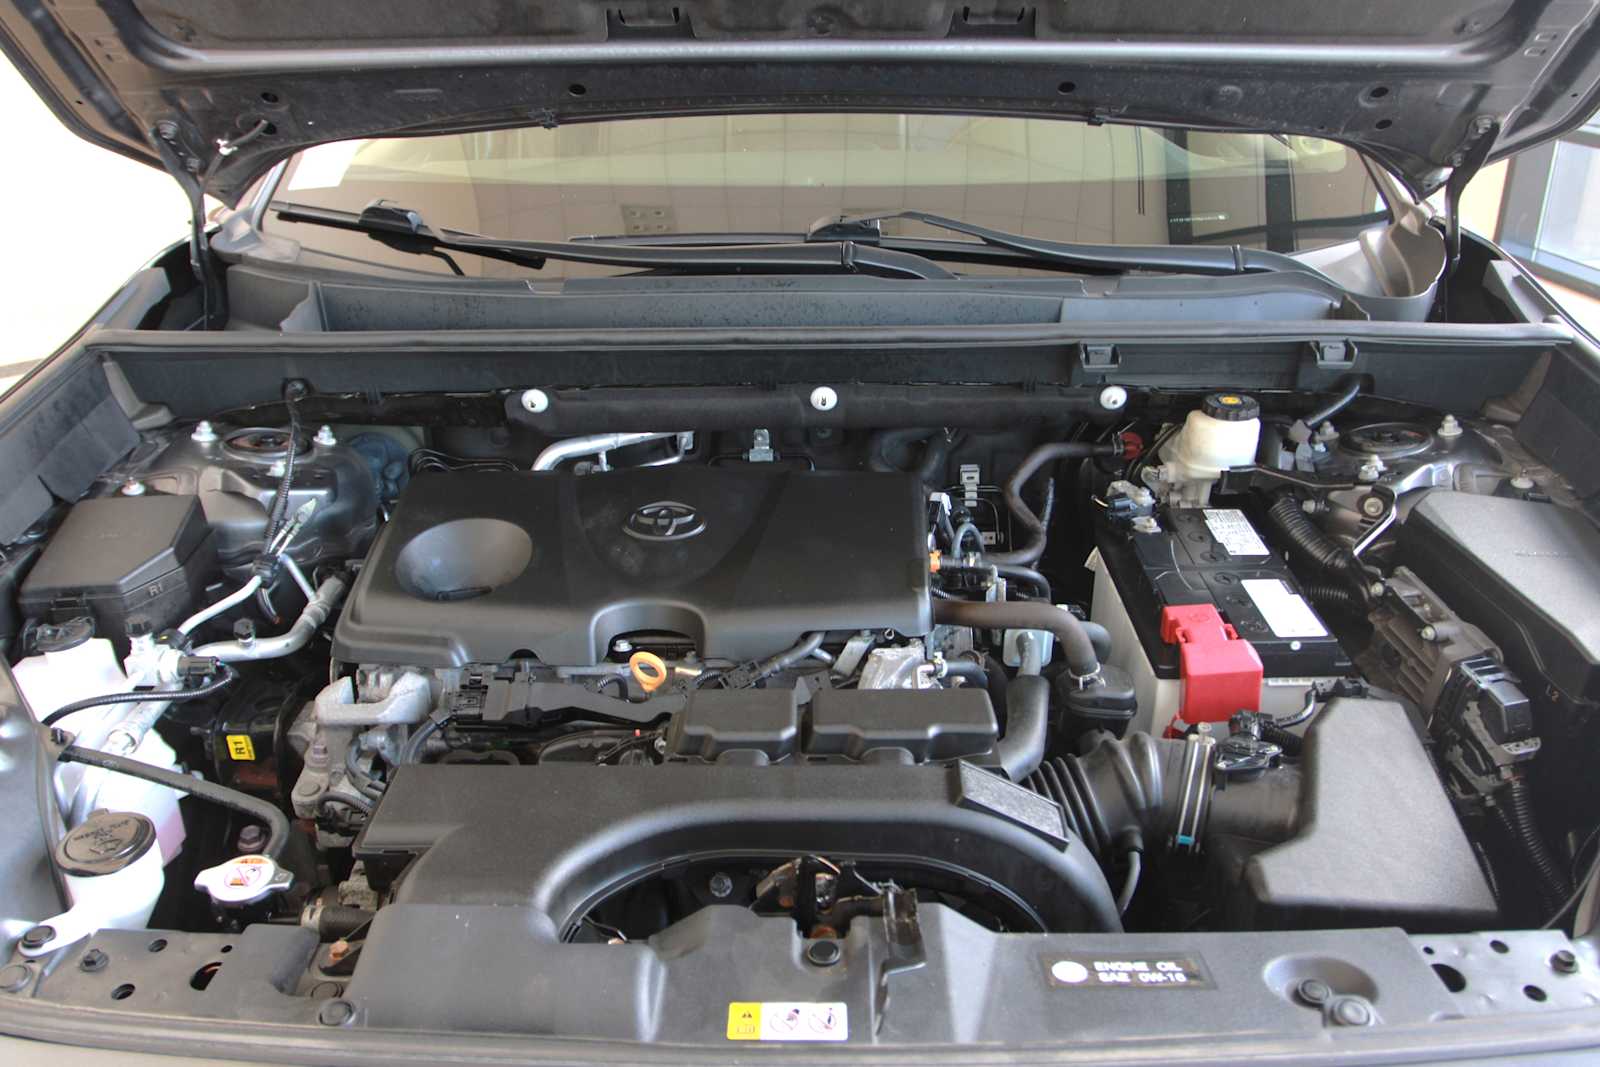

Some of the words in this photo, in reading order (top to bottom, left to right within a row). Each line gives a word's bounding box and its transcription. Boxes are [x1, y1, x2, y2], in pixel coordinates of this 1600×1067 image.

[1093, 961, 1150, 972] ENGINE
[1155, 961, 1183, 972] OIL
[1098, 972, 1131, 983] SAE
